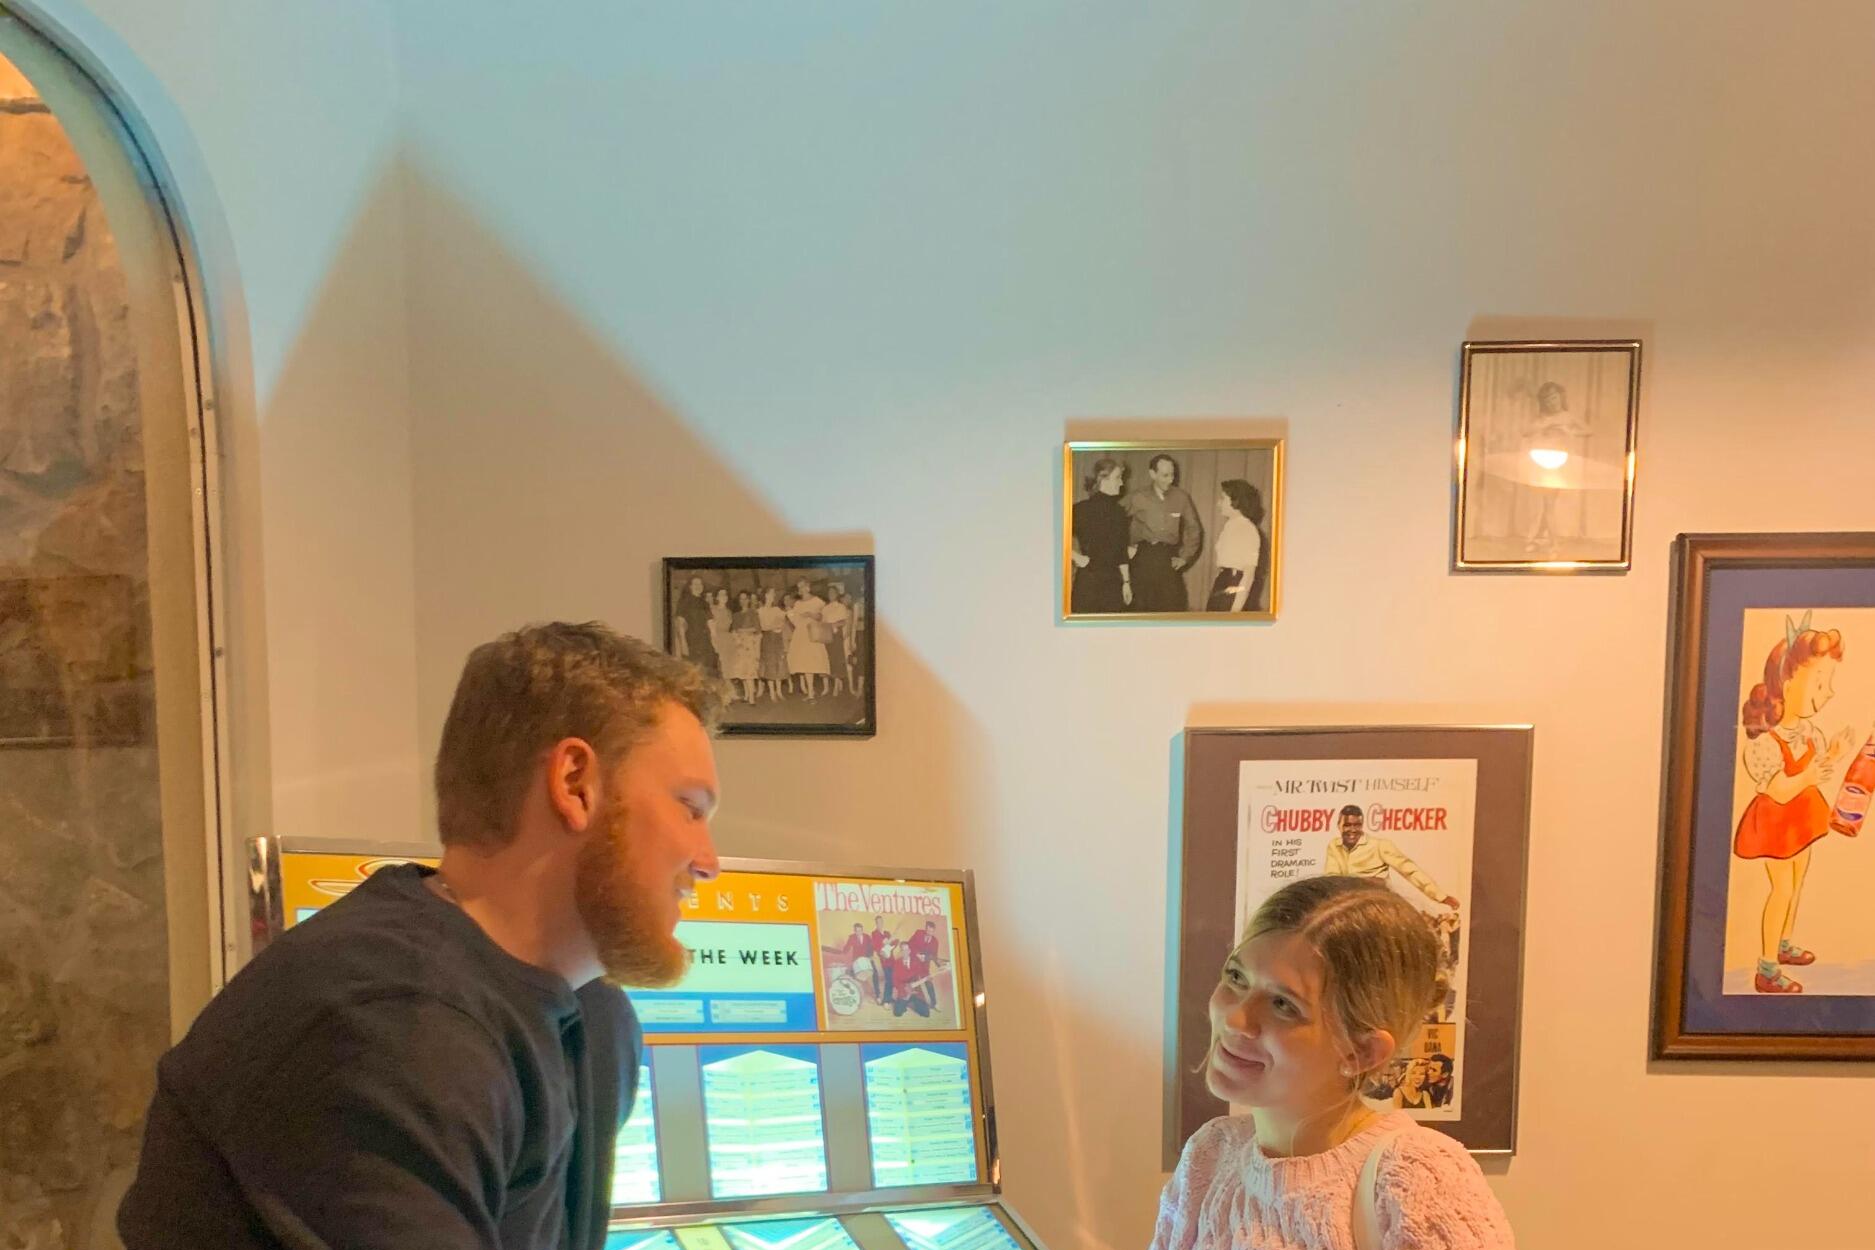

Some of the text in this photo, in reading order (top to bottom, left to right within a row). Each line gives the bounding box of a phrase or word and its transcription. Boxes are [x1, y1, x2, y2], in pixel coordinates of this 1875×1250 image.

[1261, 803, 1447, 833] CHUBBY CHECKER
[1286, 838, 1303, 846] HIS
[1271, 848, 1302, 857] FIRST
[1270, 859, 1316, 869] DRAMATIC
[816, 883, 942, 917] The Ventures
[738, 949, 799, 966] WEEK
